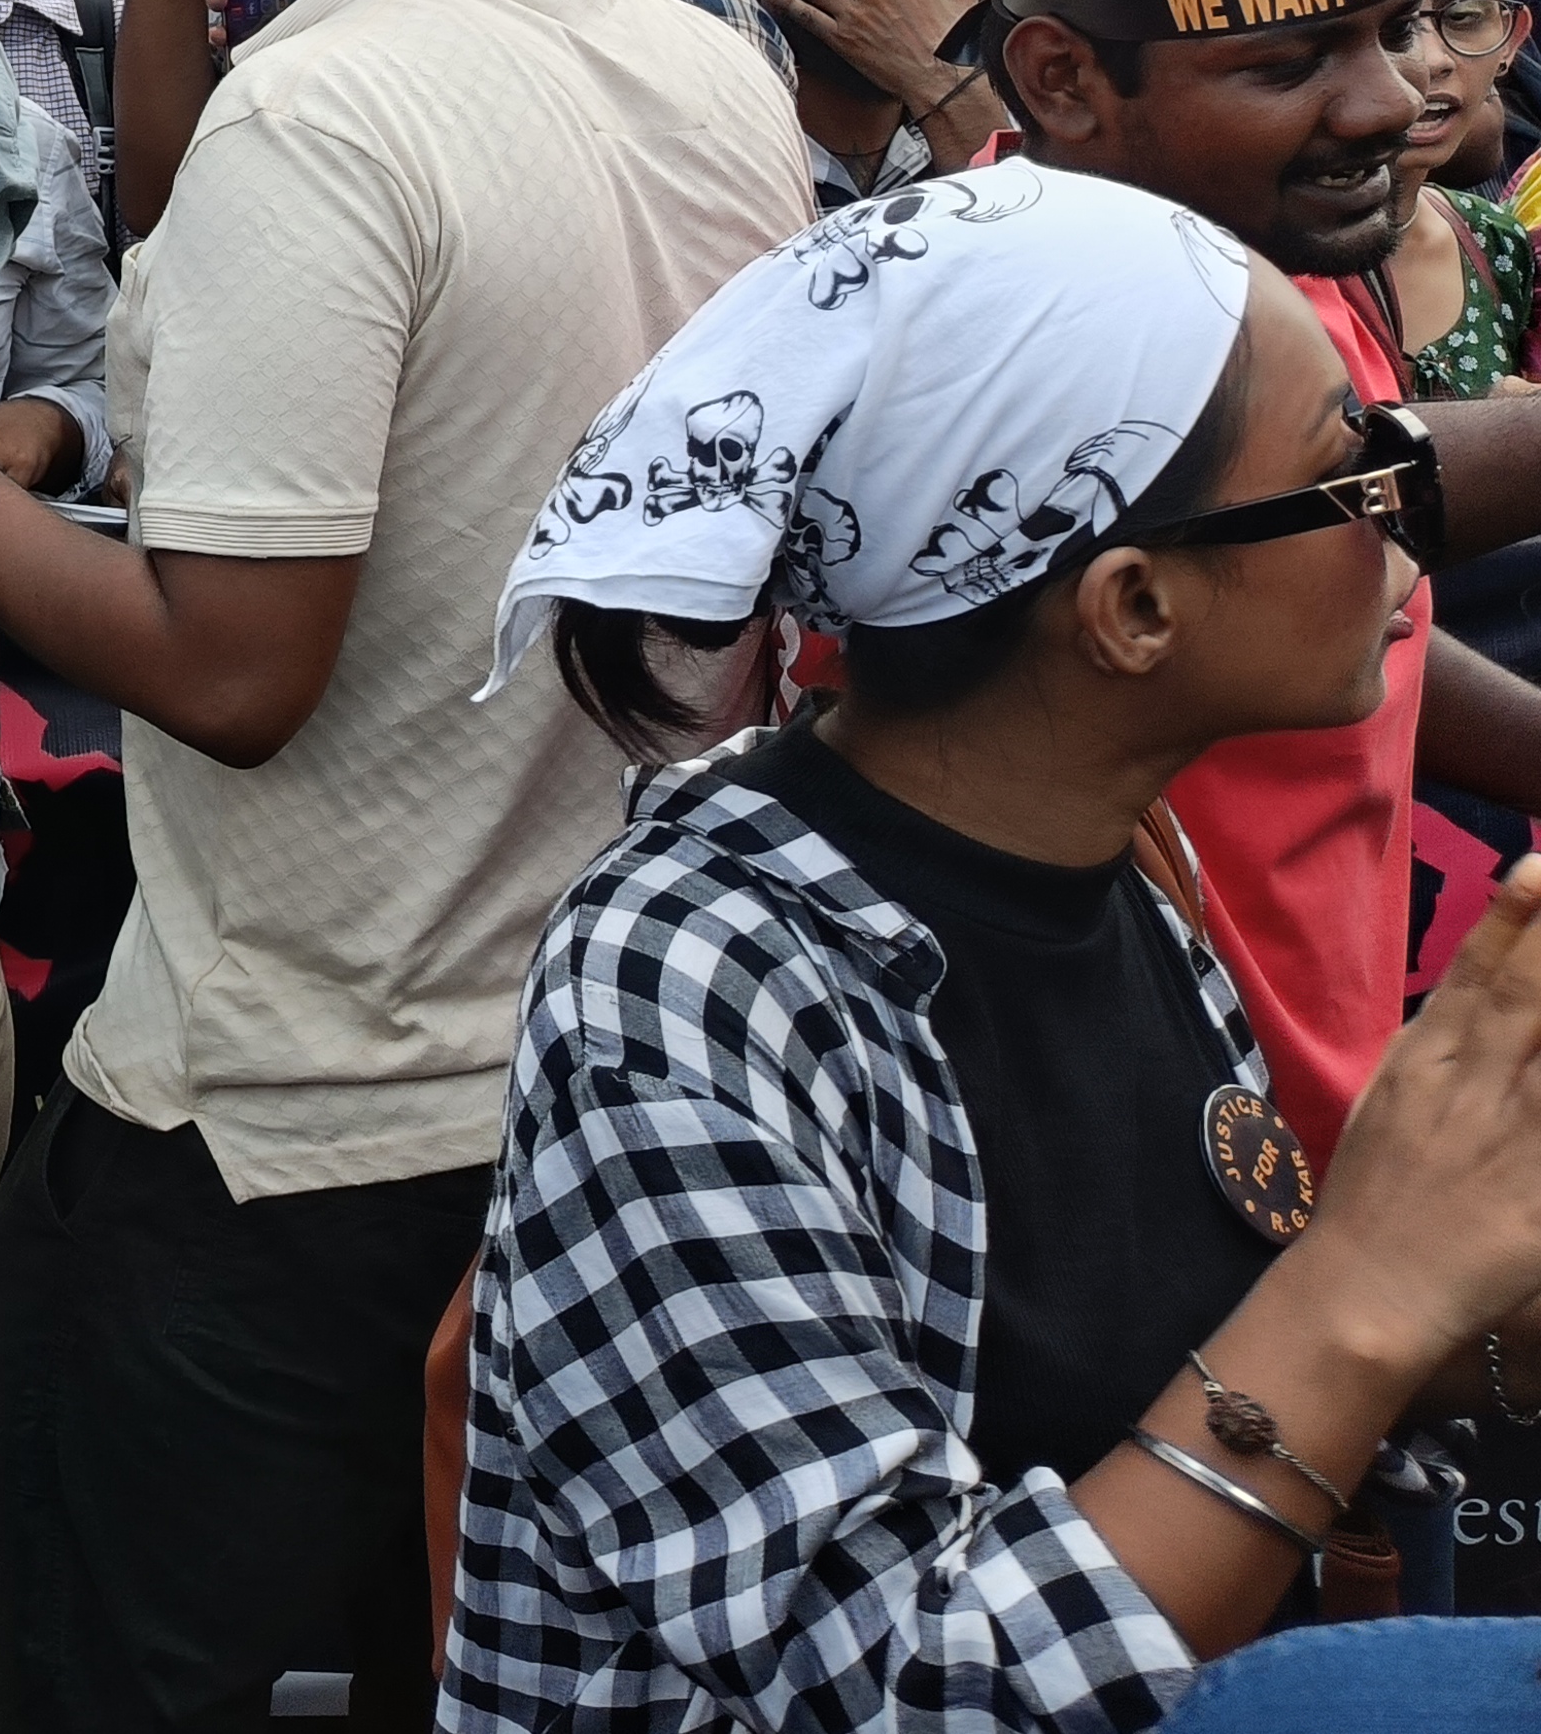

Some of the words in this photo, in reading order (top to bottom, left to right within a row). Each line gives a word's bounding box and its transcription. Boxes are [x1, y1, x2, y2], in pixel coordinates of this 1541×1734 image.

[1215, 1094, 1265, 1183] JUSTICE
[1251, 1137, 1280, 1191] FOR
[1290, 1149, 1314, 1207] KAR
